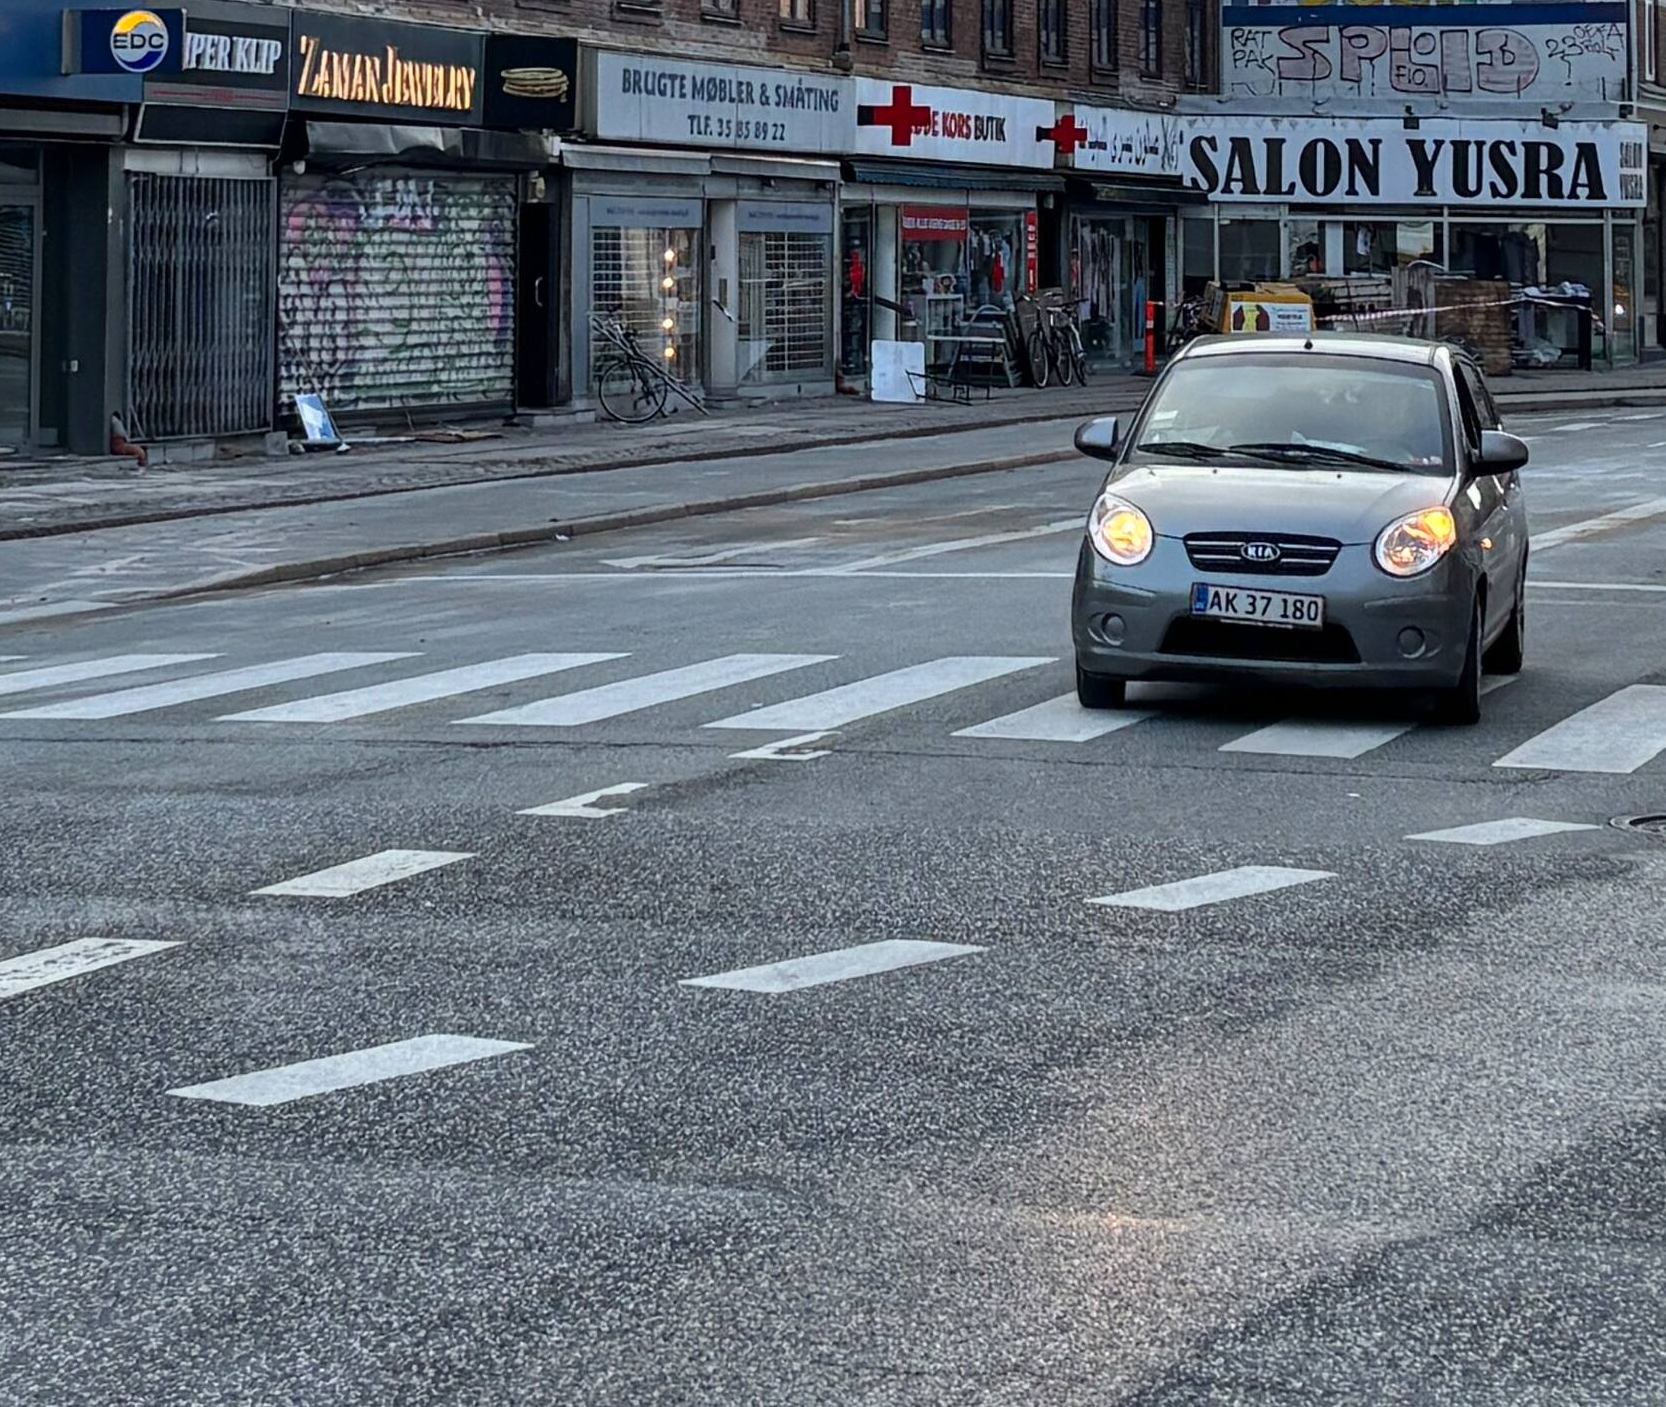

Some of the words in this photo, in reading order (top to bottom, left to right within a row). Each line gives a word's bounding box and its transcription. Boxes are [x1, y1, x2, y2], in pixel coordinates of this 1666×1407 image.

[113, 32, 164, 50] EDC
[1231, 28, 1272, 49] RAT
[233, 36, 282, 75] KLIP
[622, 68, 687, 99] BRUGTE
[691, 75, 755, 105] MØBLER
[759, 83, 770, 107] &
[774, 78, 839, 112] SMÅTING
[687, 114, 712, 137] TLF.
[717, 118, 732, 137] 35
[754, 121, 768, 140] 89
[771, 123, 785, 141] 22
[942, 111, 972, 140] KORS
[974, 115, 1006, 142] BUTIK
[1189, 135, 1383, 196] SALON
[1405, 137, 1608, 201] YUSRA
[1245, 544, 1276, 560] KIA
[1209, 590, 1236, 614] AK
[1245, 595, 1271, 617] 37
[1279, 597, 1319, 622] 180
